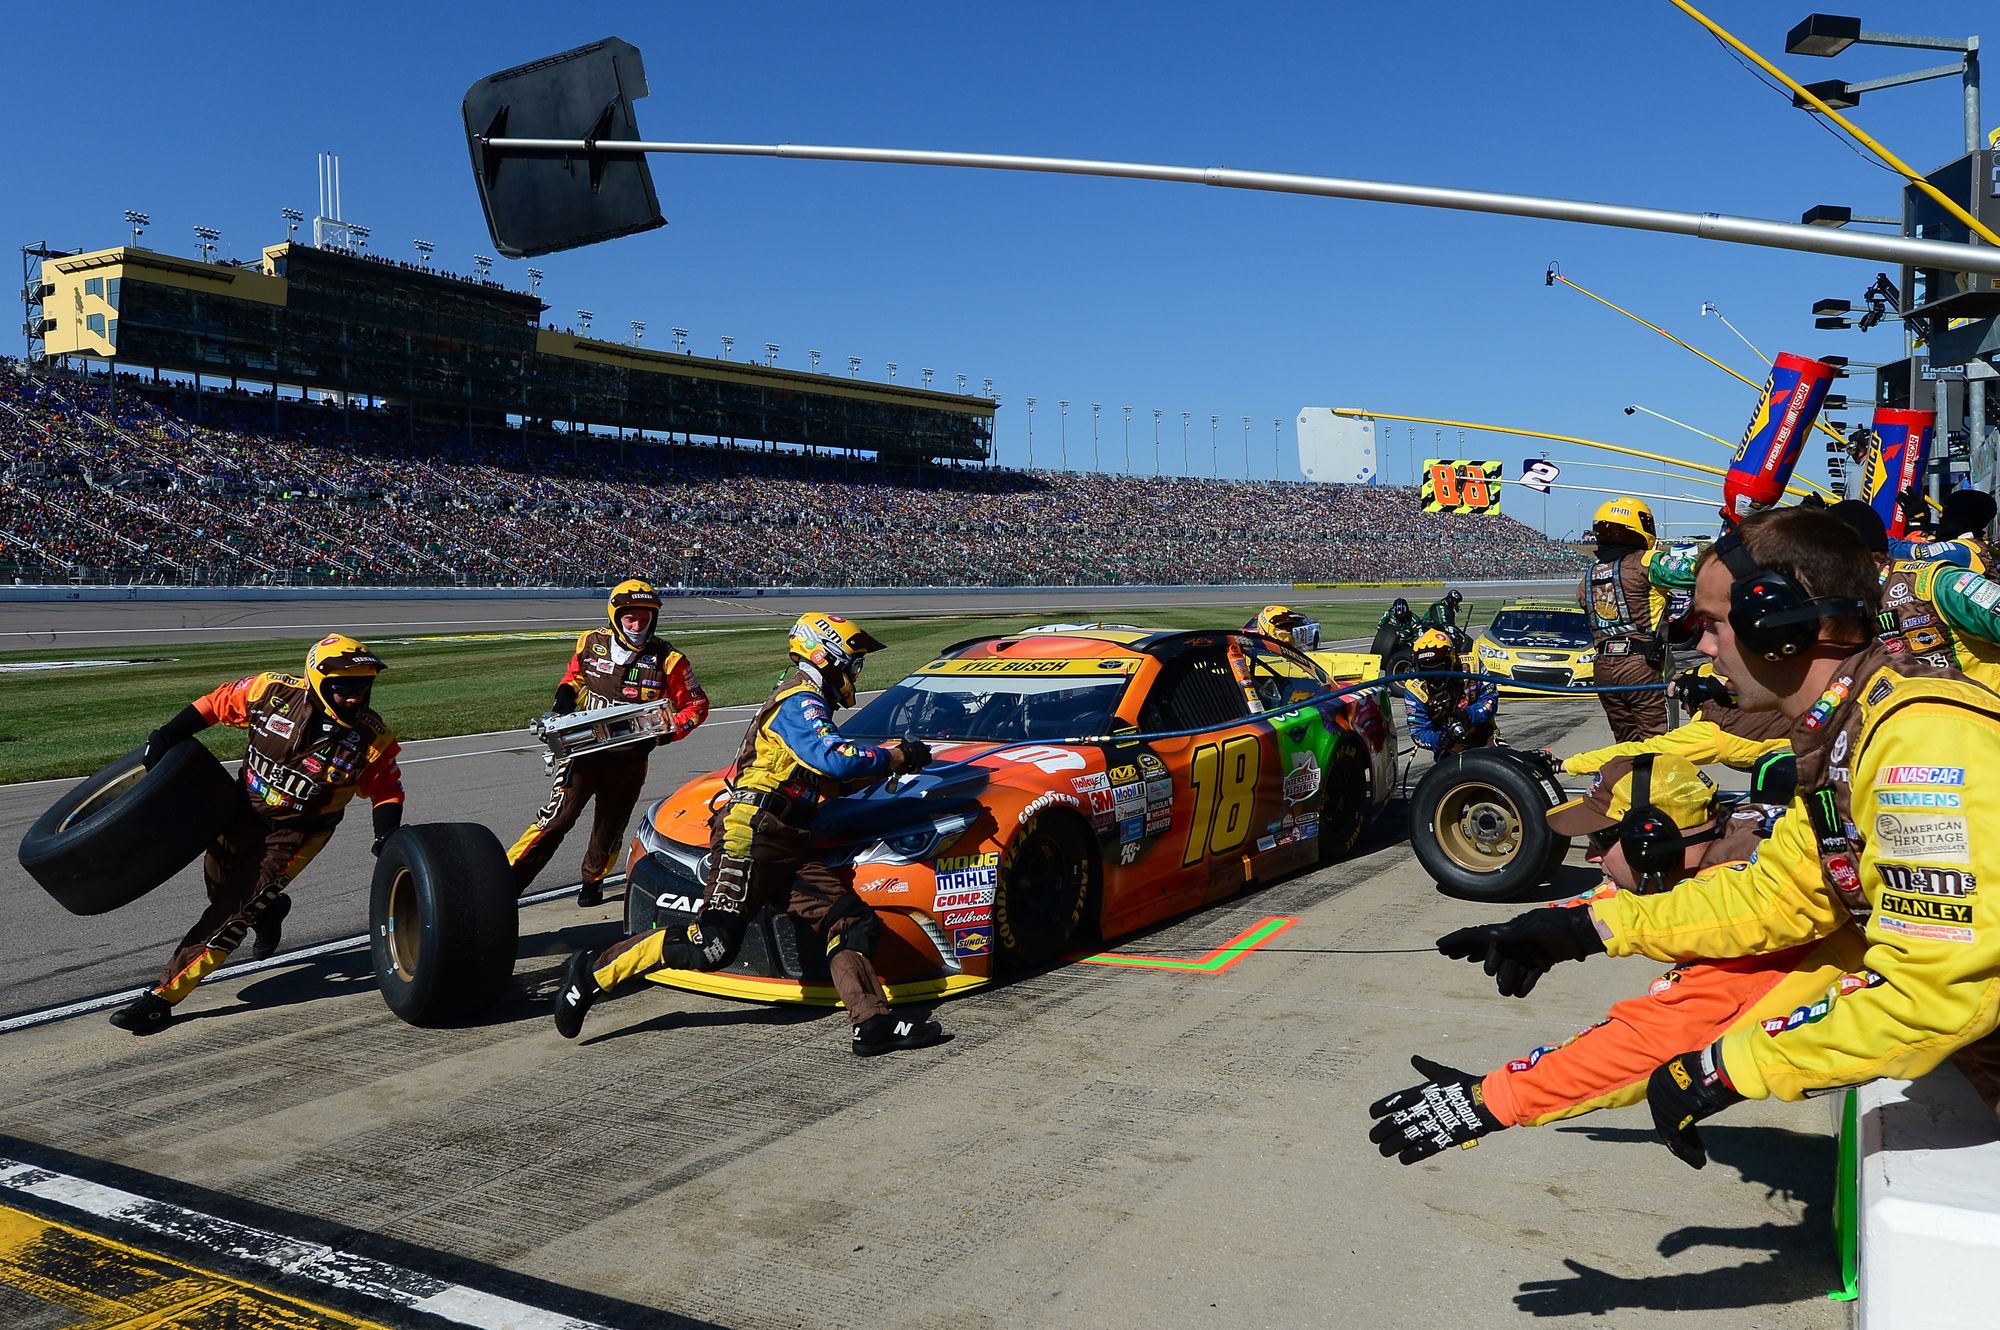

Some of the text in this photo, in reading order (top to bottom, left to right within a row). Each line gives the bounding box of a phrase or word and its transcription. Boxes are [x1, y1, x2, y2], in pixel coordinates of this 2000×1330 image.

[1735, 374, 1774, 461] SUNOCO
[1765, 382, 1811, 471] OFFICIAL FUEL NASCAR
[1907, 434, 1920, 465] NASCAR
[1861, 432, 1881, 503] UNOCO
[1431, 464, 1490, 508] 88
[1886, 595, 1915, 608] TOYOTA
[958, 661, 1070, 672] KYLE BUSCH
[1896, 767, 1960, 784] NASCAR
[1090, 789, 1114, 815] 3M
[1115, 785, 1136, 800] Mobil
[1181, 734, 1261, 869] 18
[1877, 792, 1960, 807] SIEMENS
[1018, 791, 1080, 825] GOODYEAR
[1903, 821, 1962, 835] AMERICAN
[1893, 832, 1964, 847] HERITAGE
[936, 851, 999, 872] MOOG
[936, 870, 997, 891] MAHLE
[936, 891, 982, 908] COMP
[944, 910, 993, 926] Edelbrock
[956, 935, 992, 948] SUNOCO
[893, 1021, 914, 1037] N
[1420, 1083, 1462, 1131] Mechanix
[1441, 1082, 1483, 1131] Mechanix
